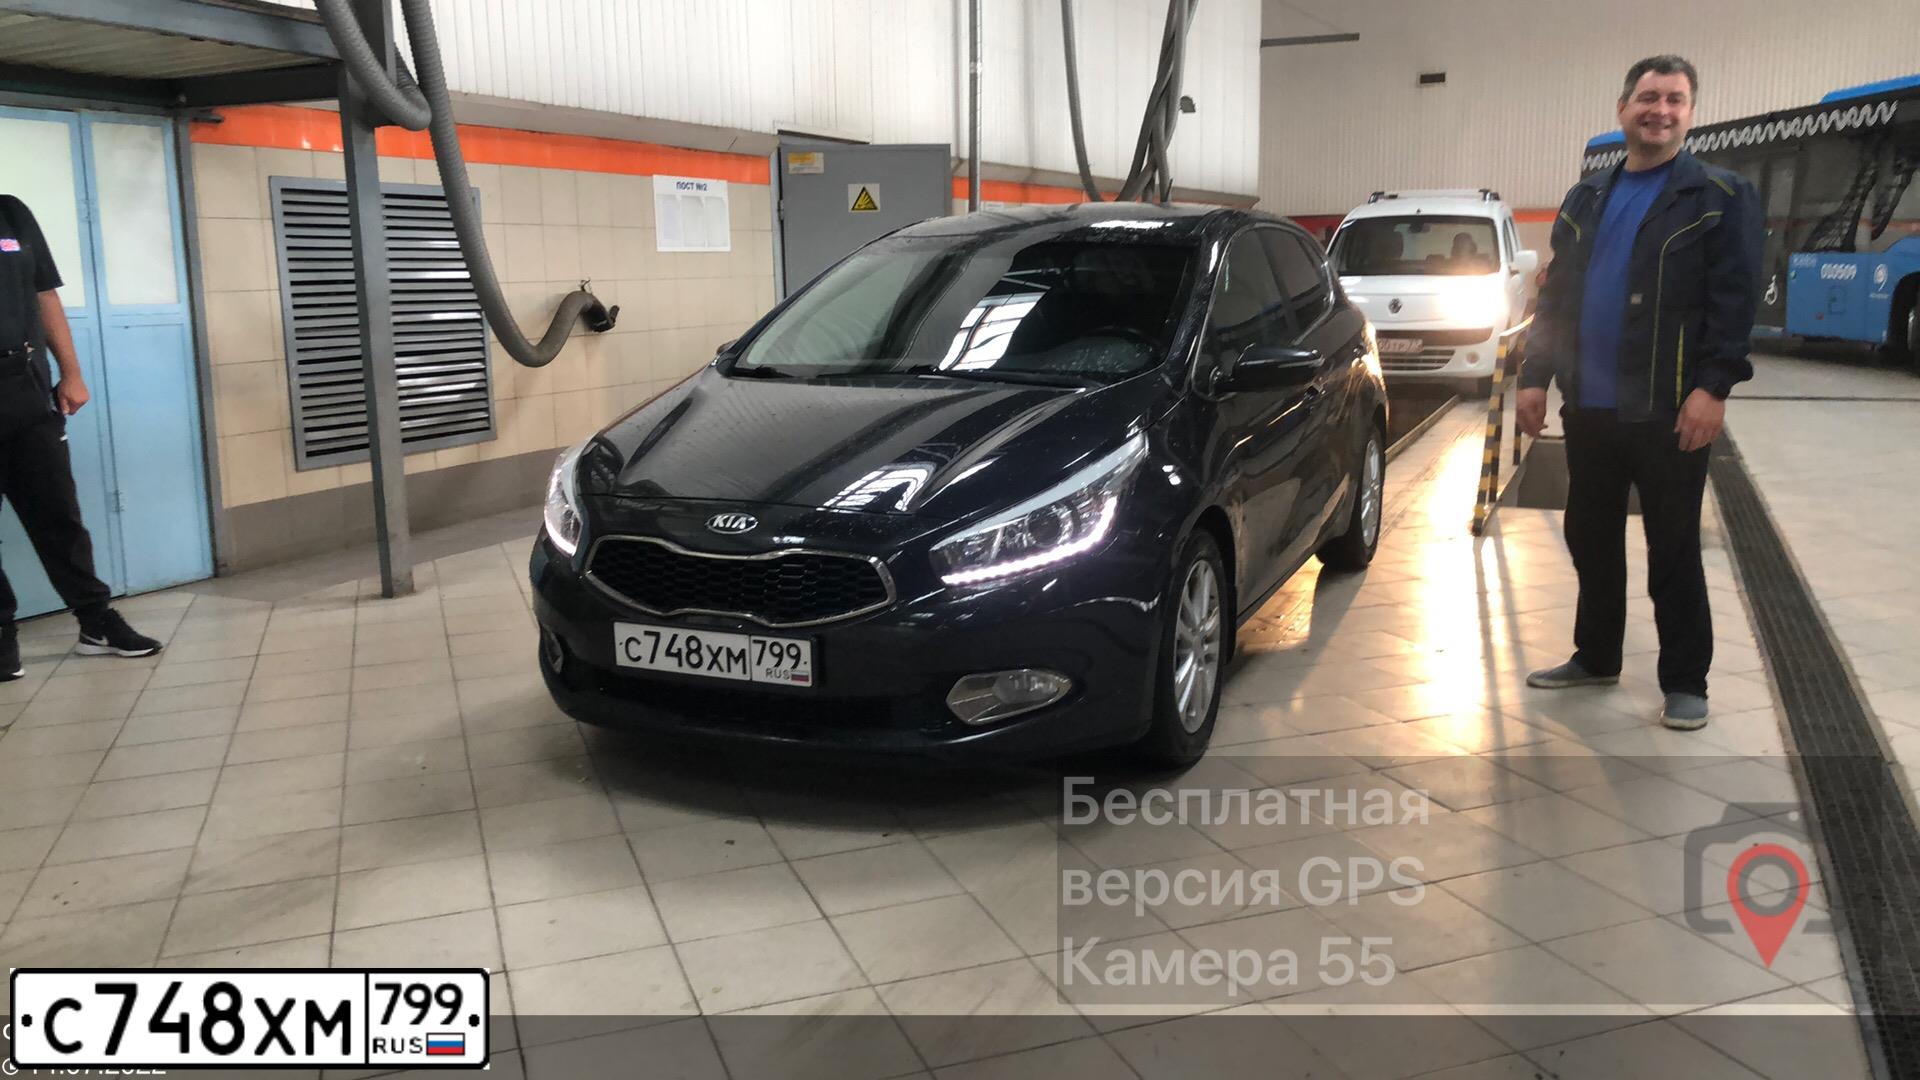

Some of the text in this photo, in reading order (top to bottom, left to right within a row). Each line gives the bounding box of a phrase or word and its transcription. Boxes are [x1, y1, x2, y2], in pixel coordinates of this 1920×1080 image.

[676, 181, 694, 190] ПОСТ
[712, 515, 747, 530] KIA
[624, 630, 801, 675] С748ХМ 799
[765, 667, 790, 680] RUS
